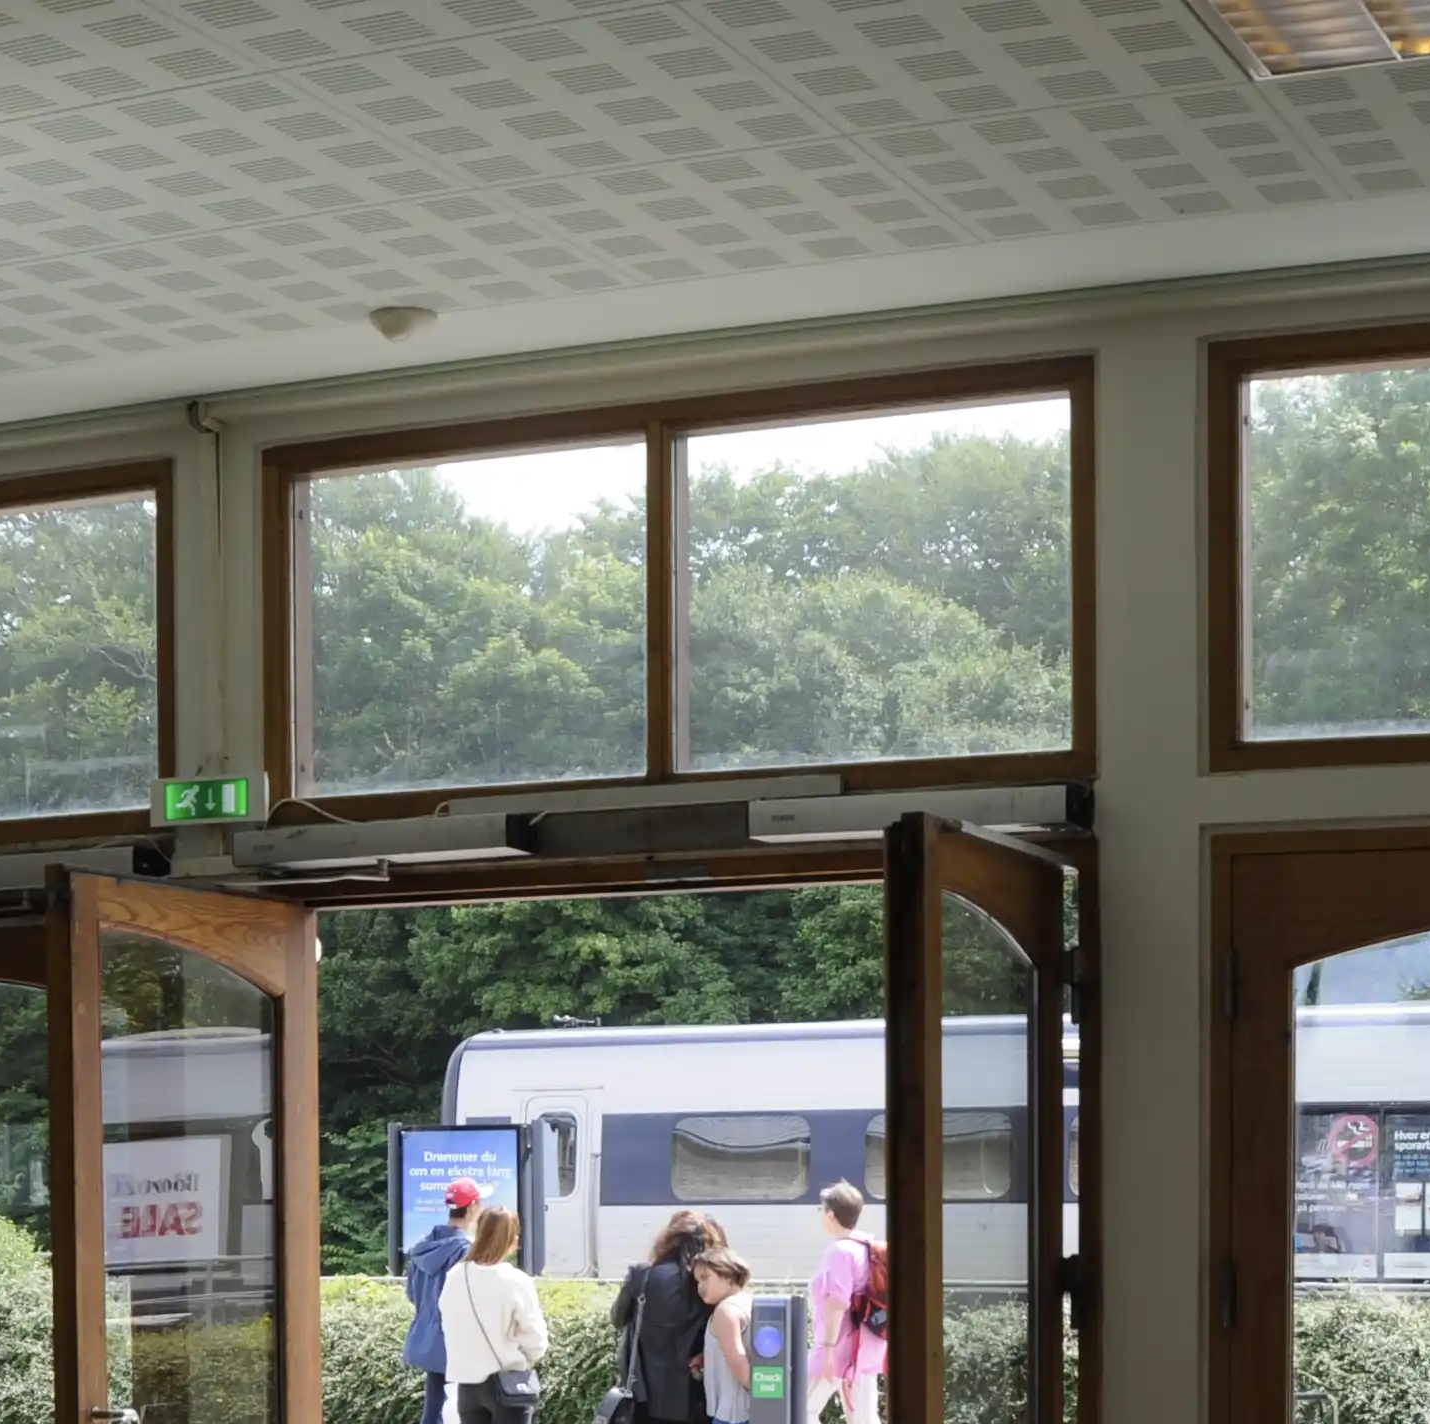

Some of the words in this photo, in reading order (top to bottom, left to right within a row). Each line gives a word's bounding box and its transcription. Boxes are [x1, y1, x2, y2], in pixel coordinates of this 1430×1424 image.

[481, 1150, 497, 1163] du
[409, 1167, 428, 1177] om
[430, 1167, 445, 1177] en
[447, 1165, 485, 1177] ekstra
